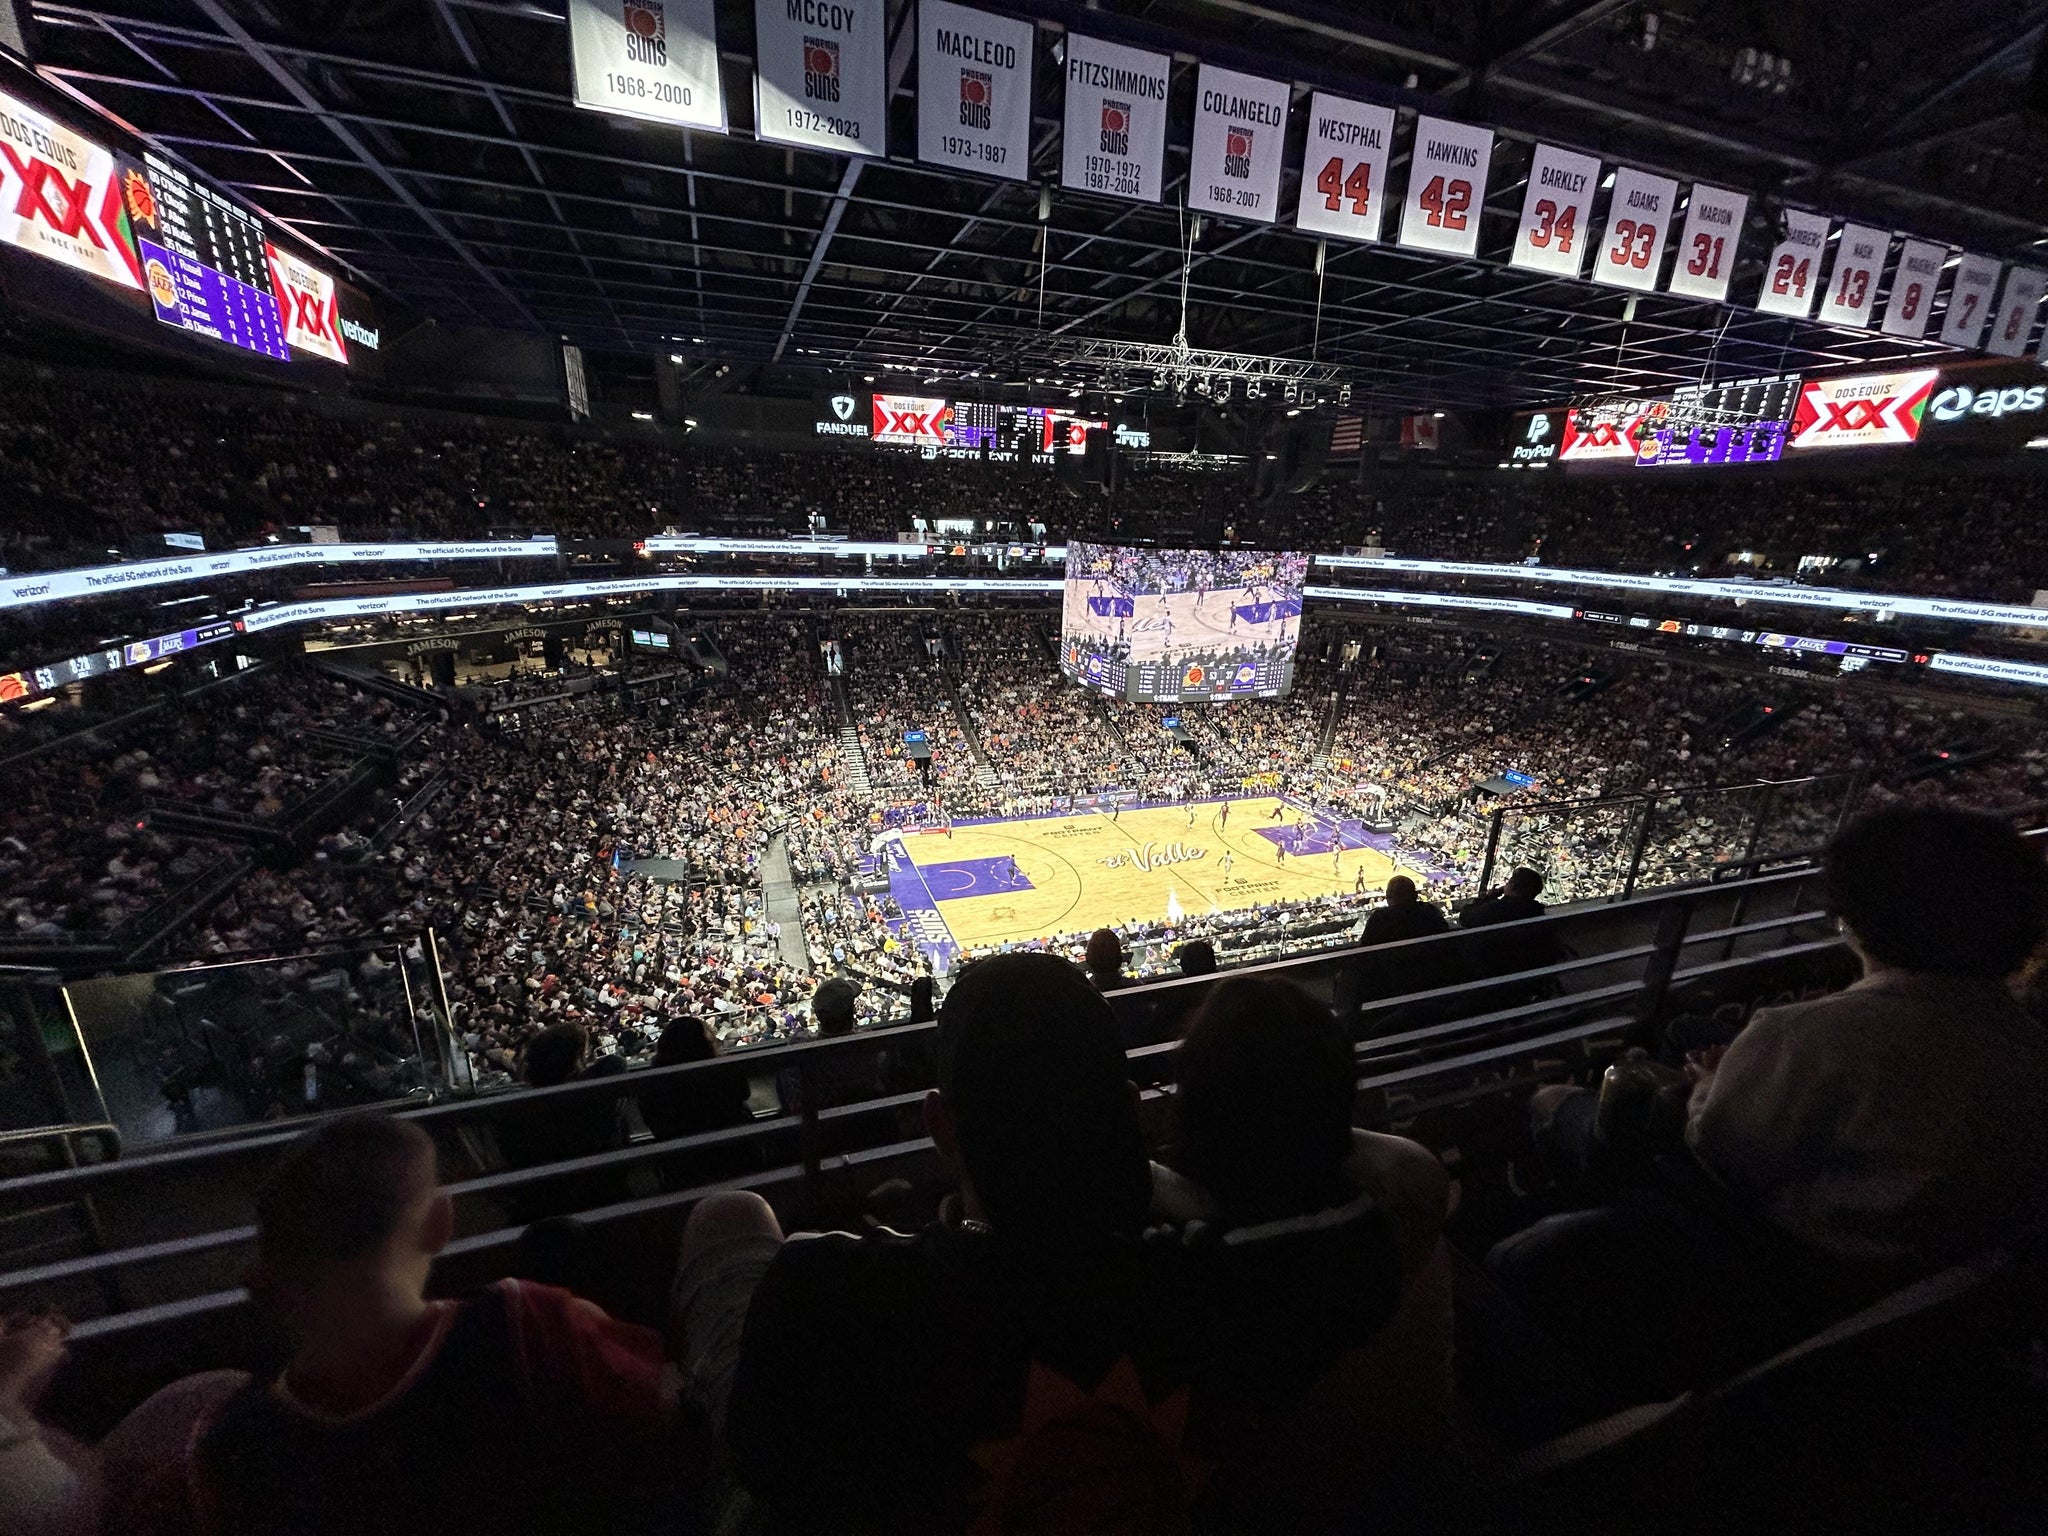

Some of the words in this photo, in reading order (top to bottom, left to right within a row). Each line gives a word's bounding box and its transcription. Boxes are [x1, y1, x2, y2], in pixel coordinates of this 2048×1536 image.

[787, 0, 854, 33] MCCOY
[937, 28, 1016, 70] MACLEOD
[606, 73, 692, 106] 1968-2000
[1070, 59, 1165, 101] FITZSIMMONS
[1203, 90, 1281, 128] COLANGELO
[787, 108, 860, 139] 1972-2023
[1319, 117, 1382, 149] WESTPHAL
[0, 111, 32, 148] DOS
[33, 129, 77, 171] EQUIS
[942, 136, 1006, 164] 1973-1987
[1426, 140, 1478, 168] HAWKINS
[1085, 155, 1141, 179] 1970-1972
[1541, 166, 1588, 193] BARKLEY
[1084, 172, 1140, 196] 1987-2004
[1208, 185, 1260, 208] 1968-2007
[1317, 156, 1371, 216] 44
[1420, 175, 1472, 231] 42
[1626, 189, 1660, 212] ADAMS
[1529, 199, 1577, 254] 34
[1610, 218, 1657, 270] 33
[1687, 232, 1725, 279] 31
[1772, 254, 1811, 298] 24
[1835, 267, 1870, 309] 13
[287, 283, 332, 342] XX
[1901, 282, 1923, 321] 9
[341, 318, 377, 350] verizon
[1834, 387, 1856, 399] DOS
[1857, 384, 1893, 397] EQUIS
[1973, 385, 2048, 417] aps
[889, 411, 930, 434] XX
[1815, 396, 1900, 432] XX
[816, 421, 869, 437] FANDUEL
[1512, 443, 1556, 460] PayPal
[353, 548, 382, 557] verizon
[86, 576, 101, 586] The
[102, 573, 125, 584] official
[126, 571, 136, 581] 5G
[136, 568, 162, 580] network
[162, 567, 168, 576] of
[169, 566, 178, 575] the
[178, 565, 192, 574] Suns
[13, 584, 48, 598] verizon
[357, 602, 387, 610] verizon
[1948, 607, 1979, 615] official
[1995, 612, 2036, 620] network
[503, 629, 548, 644] JAMESON
[586, 620, 623, 633] JAMESON
[1687, 624, 1699, 635] 53
[1741, 631, 1755, 642] 37
[106, 649, 121, 669] 37
[406, 638, 460, 656] JAMESON
[35, 667, 55, 690] 53
[1209, 671, 1218, 680] 53
[1226, 670, 1233, 680] 37
[1937, 658, 1953, 666] The
[1955, 661, 1985, 670] official
[2002, 668, 2041, 678] network
[1121, 841, 1208, 873] Valle
